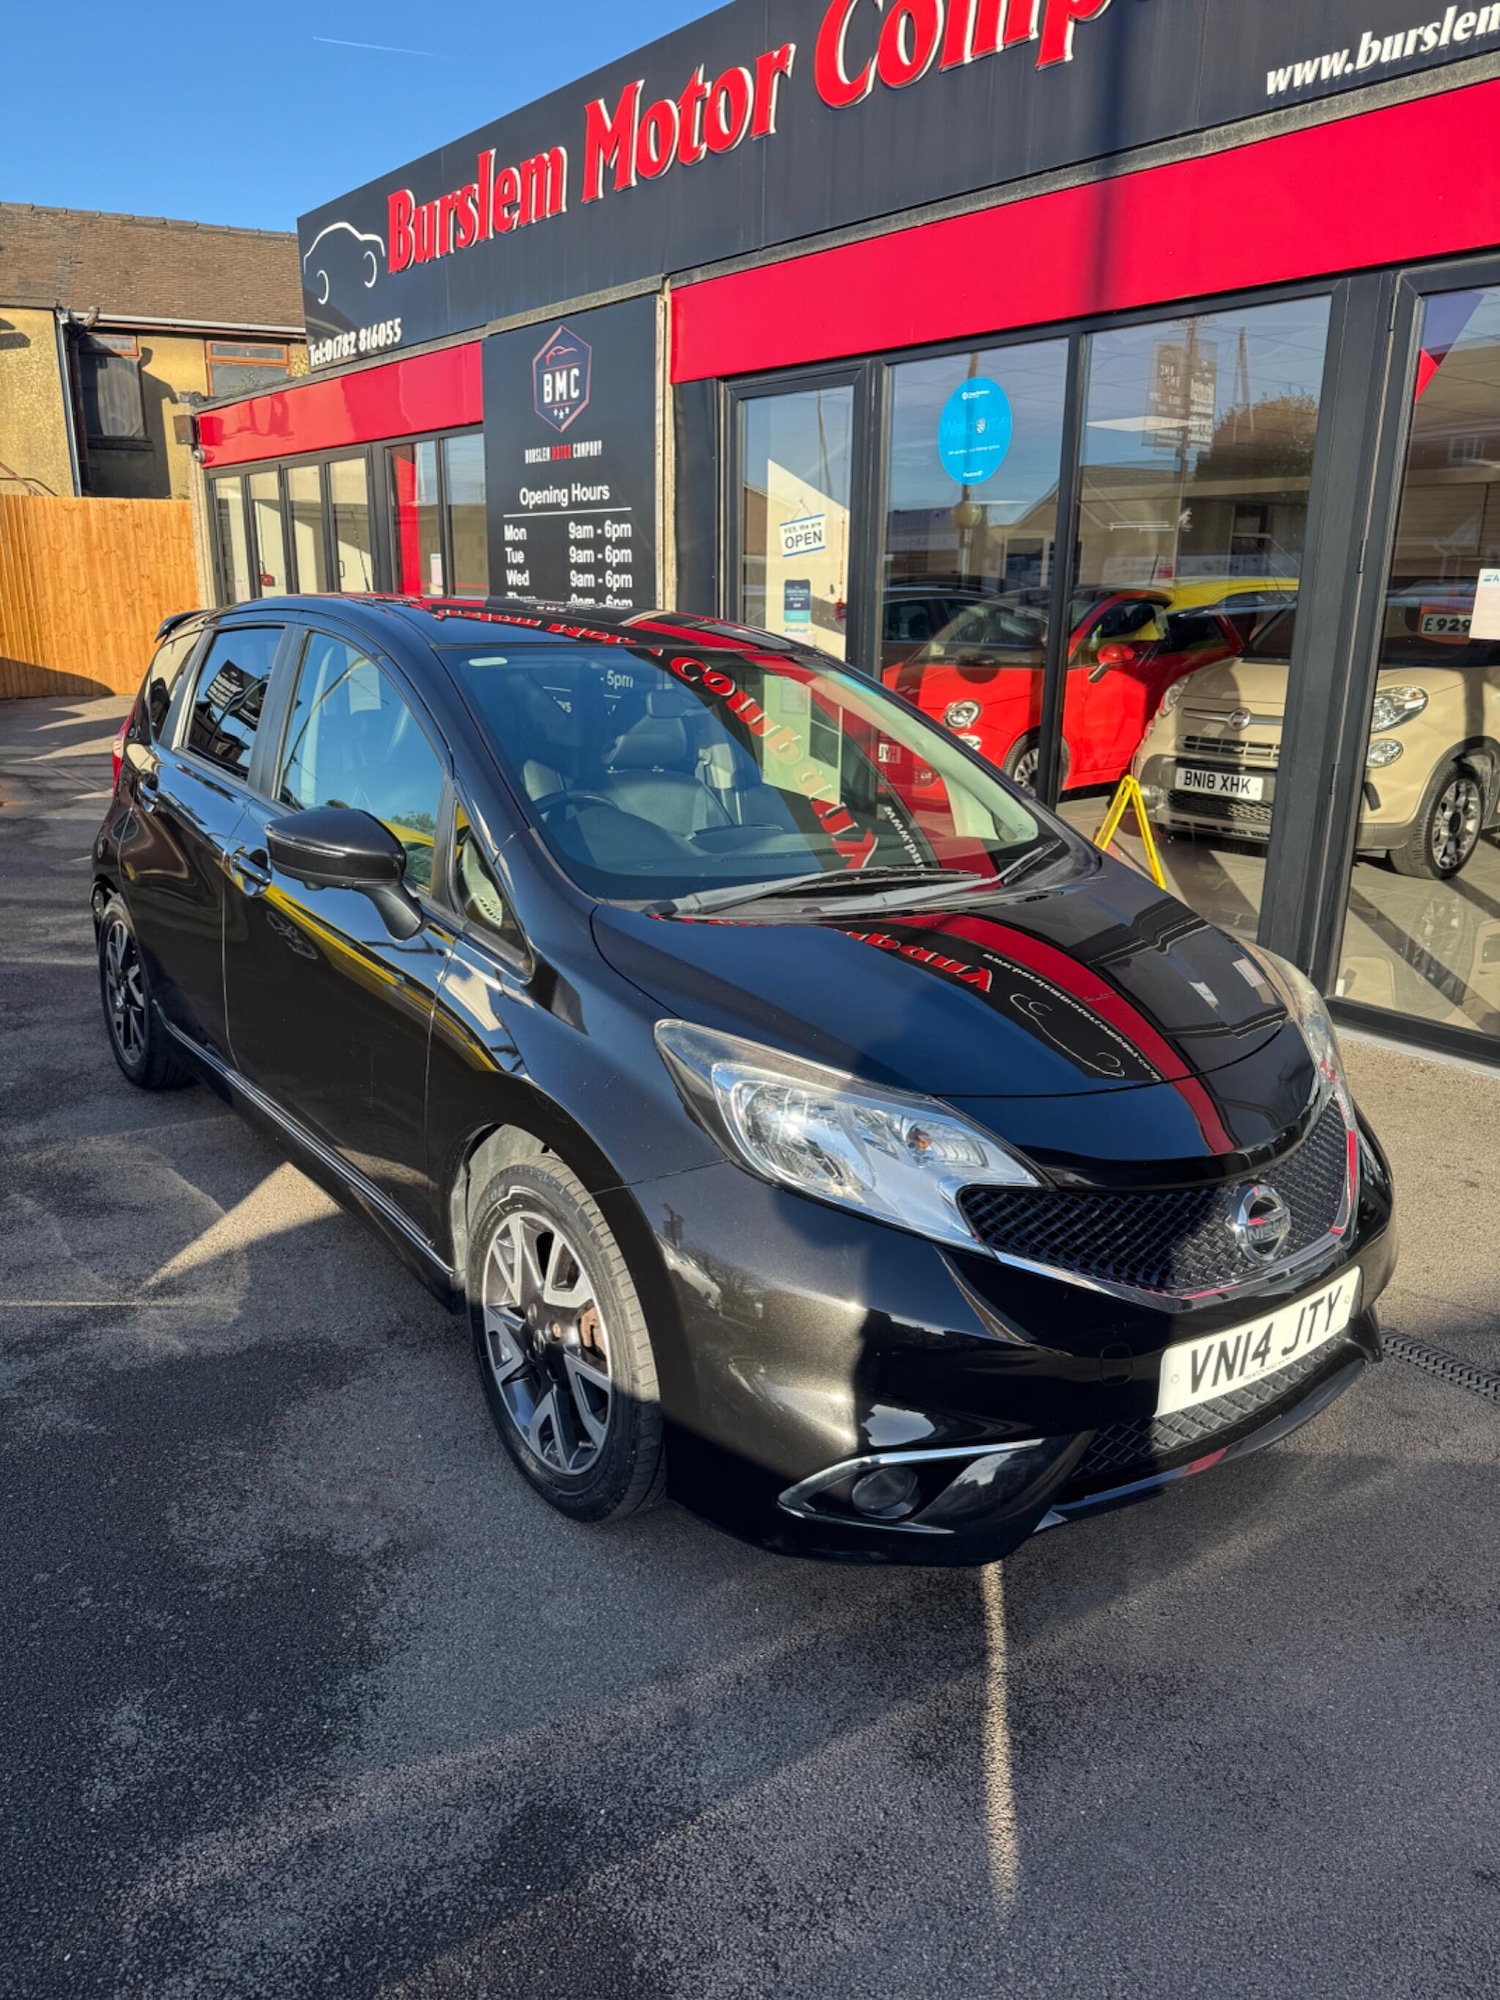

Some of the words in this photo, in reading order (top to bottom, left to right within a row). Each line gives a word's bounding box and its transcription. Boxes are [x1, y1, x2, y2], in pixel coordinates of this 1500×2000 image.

[388, 147, 567, 274] Burslem
[581, 42, 797, 204] Motor
[358, 317, 402, 352] 816055
[543, 368, 580, 404] BMC
[942, 416, 1009, 437] Welcme
[519, 484, 569, 510] Opening
[571, 482, 611, 502] Hours
[504, 525, 527, 541] Mon
[568, 521, 594, 539] 9am
[605, 520, 633, 542] 6pm
[784, 529, 823, 550] OPEN
[505, 547, 525, 564] Tue
[569, 546, 594, 563] 9am
[605, 545, 633, 567] 6pm
[506, 570, 530, 587] Wed
[569, 570, 595, 587] 9am
[606, 570, 633, 591] 6pm
[606, 669, 634, 690] 5pm
[1184, 770, 1216, 790] BN18
[1220, 775, 1252, 794] XHK
[1190, 1321, 1275, 1394] VN14
[1281, 1285, 1343, 1357] JTY
